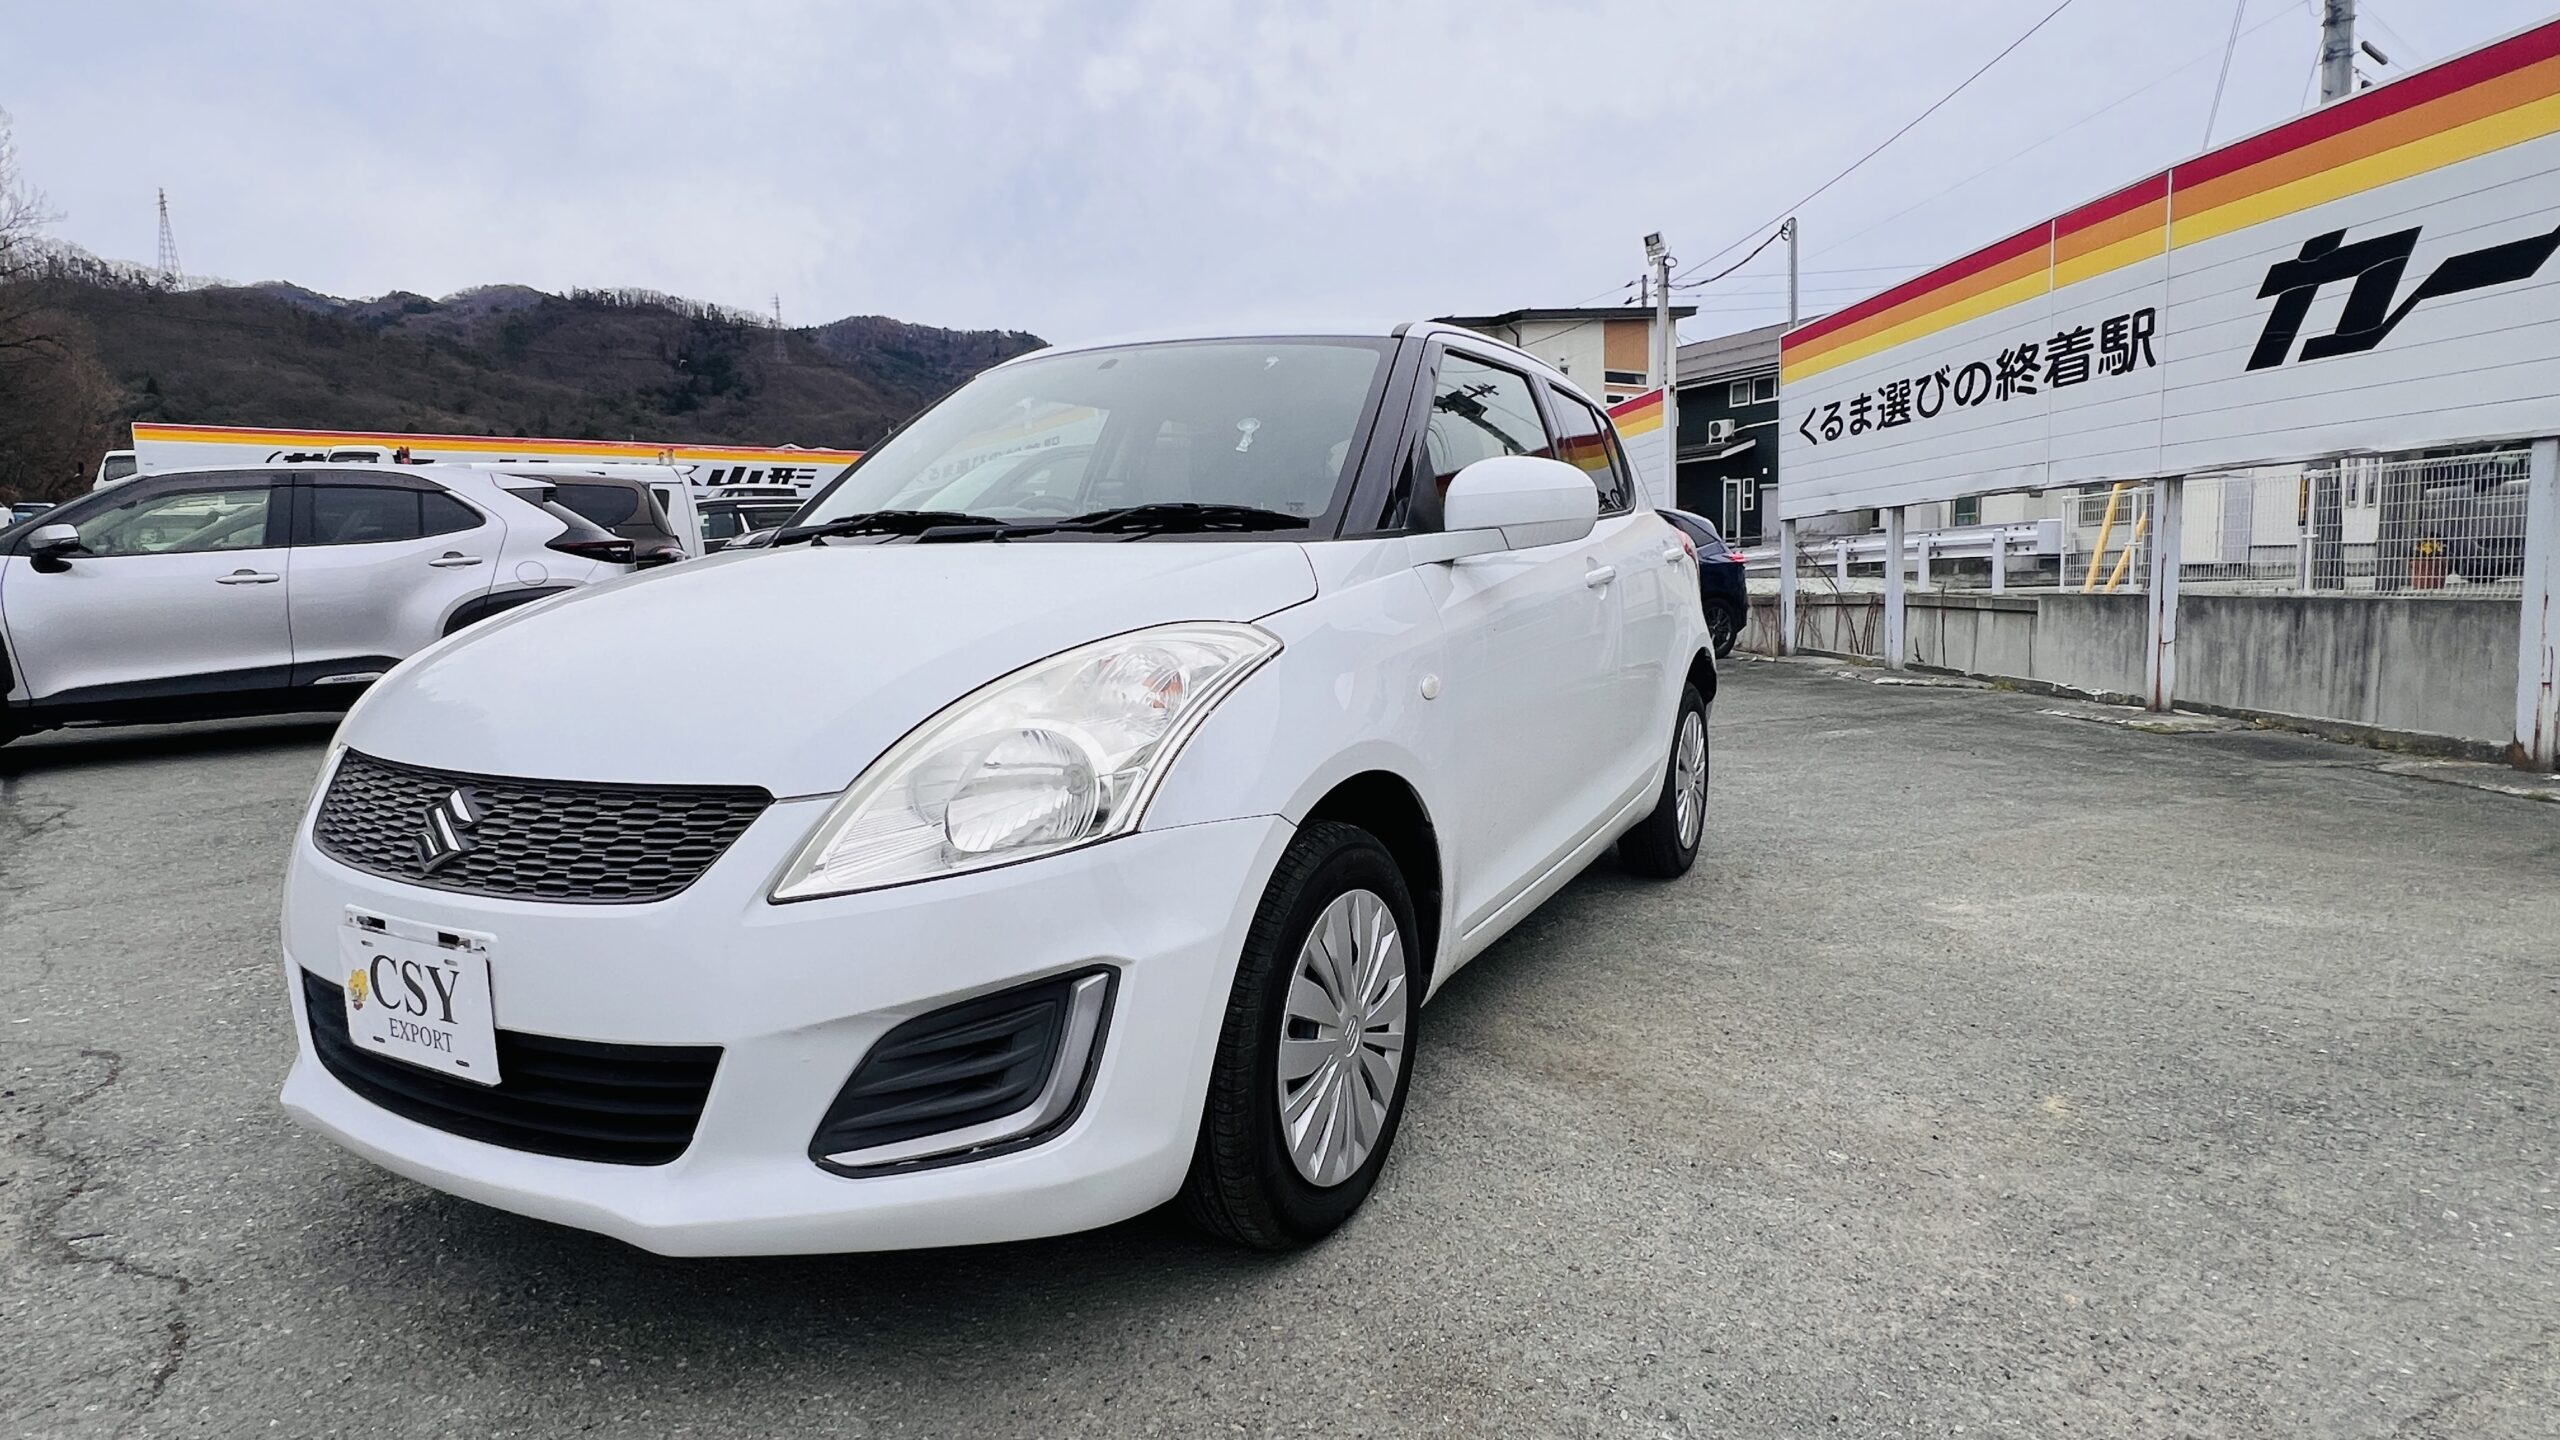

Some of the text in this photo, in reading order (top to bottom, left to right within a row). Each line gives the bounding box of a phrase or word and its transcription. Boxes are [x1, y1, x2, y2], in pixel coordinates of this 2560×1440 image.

[1799, 307, 2156, 445] くるま選びの終着駅
[688, 465, 818, 488] 山形
[370, 954, 460, 1025] CSY
[389, 1017, 453, 1053] EXPORT
